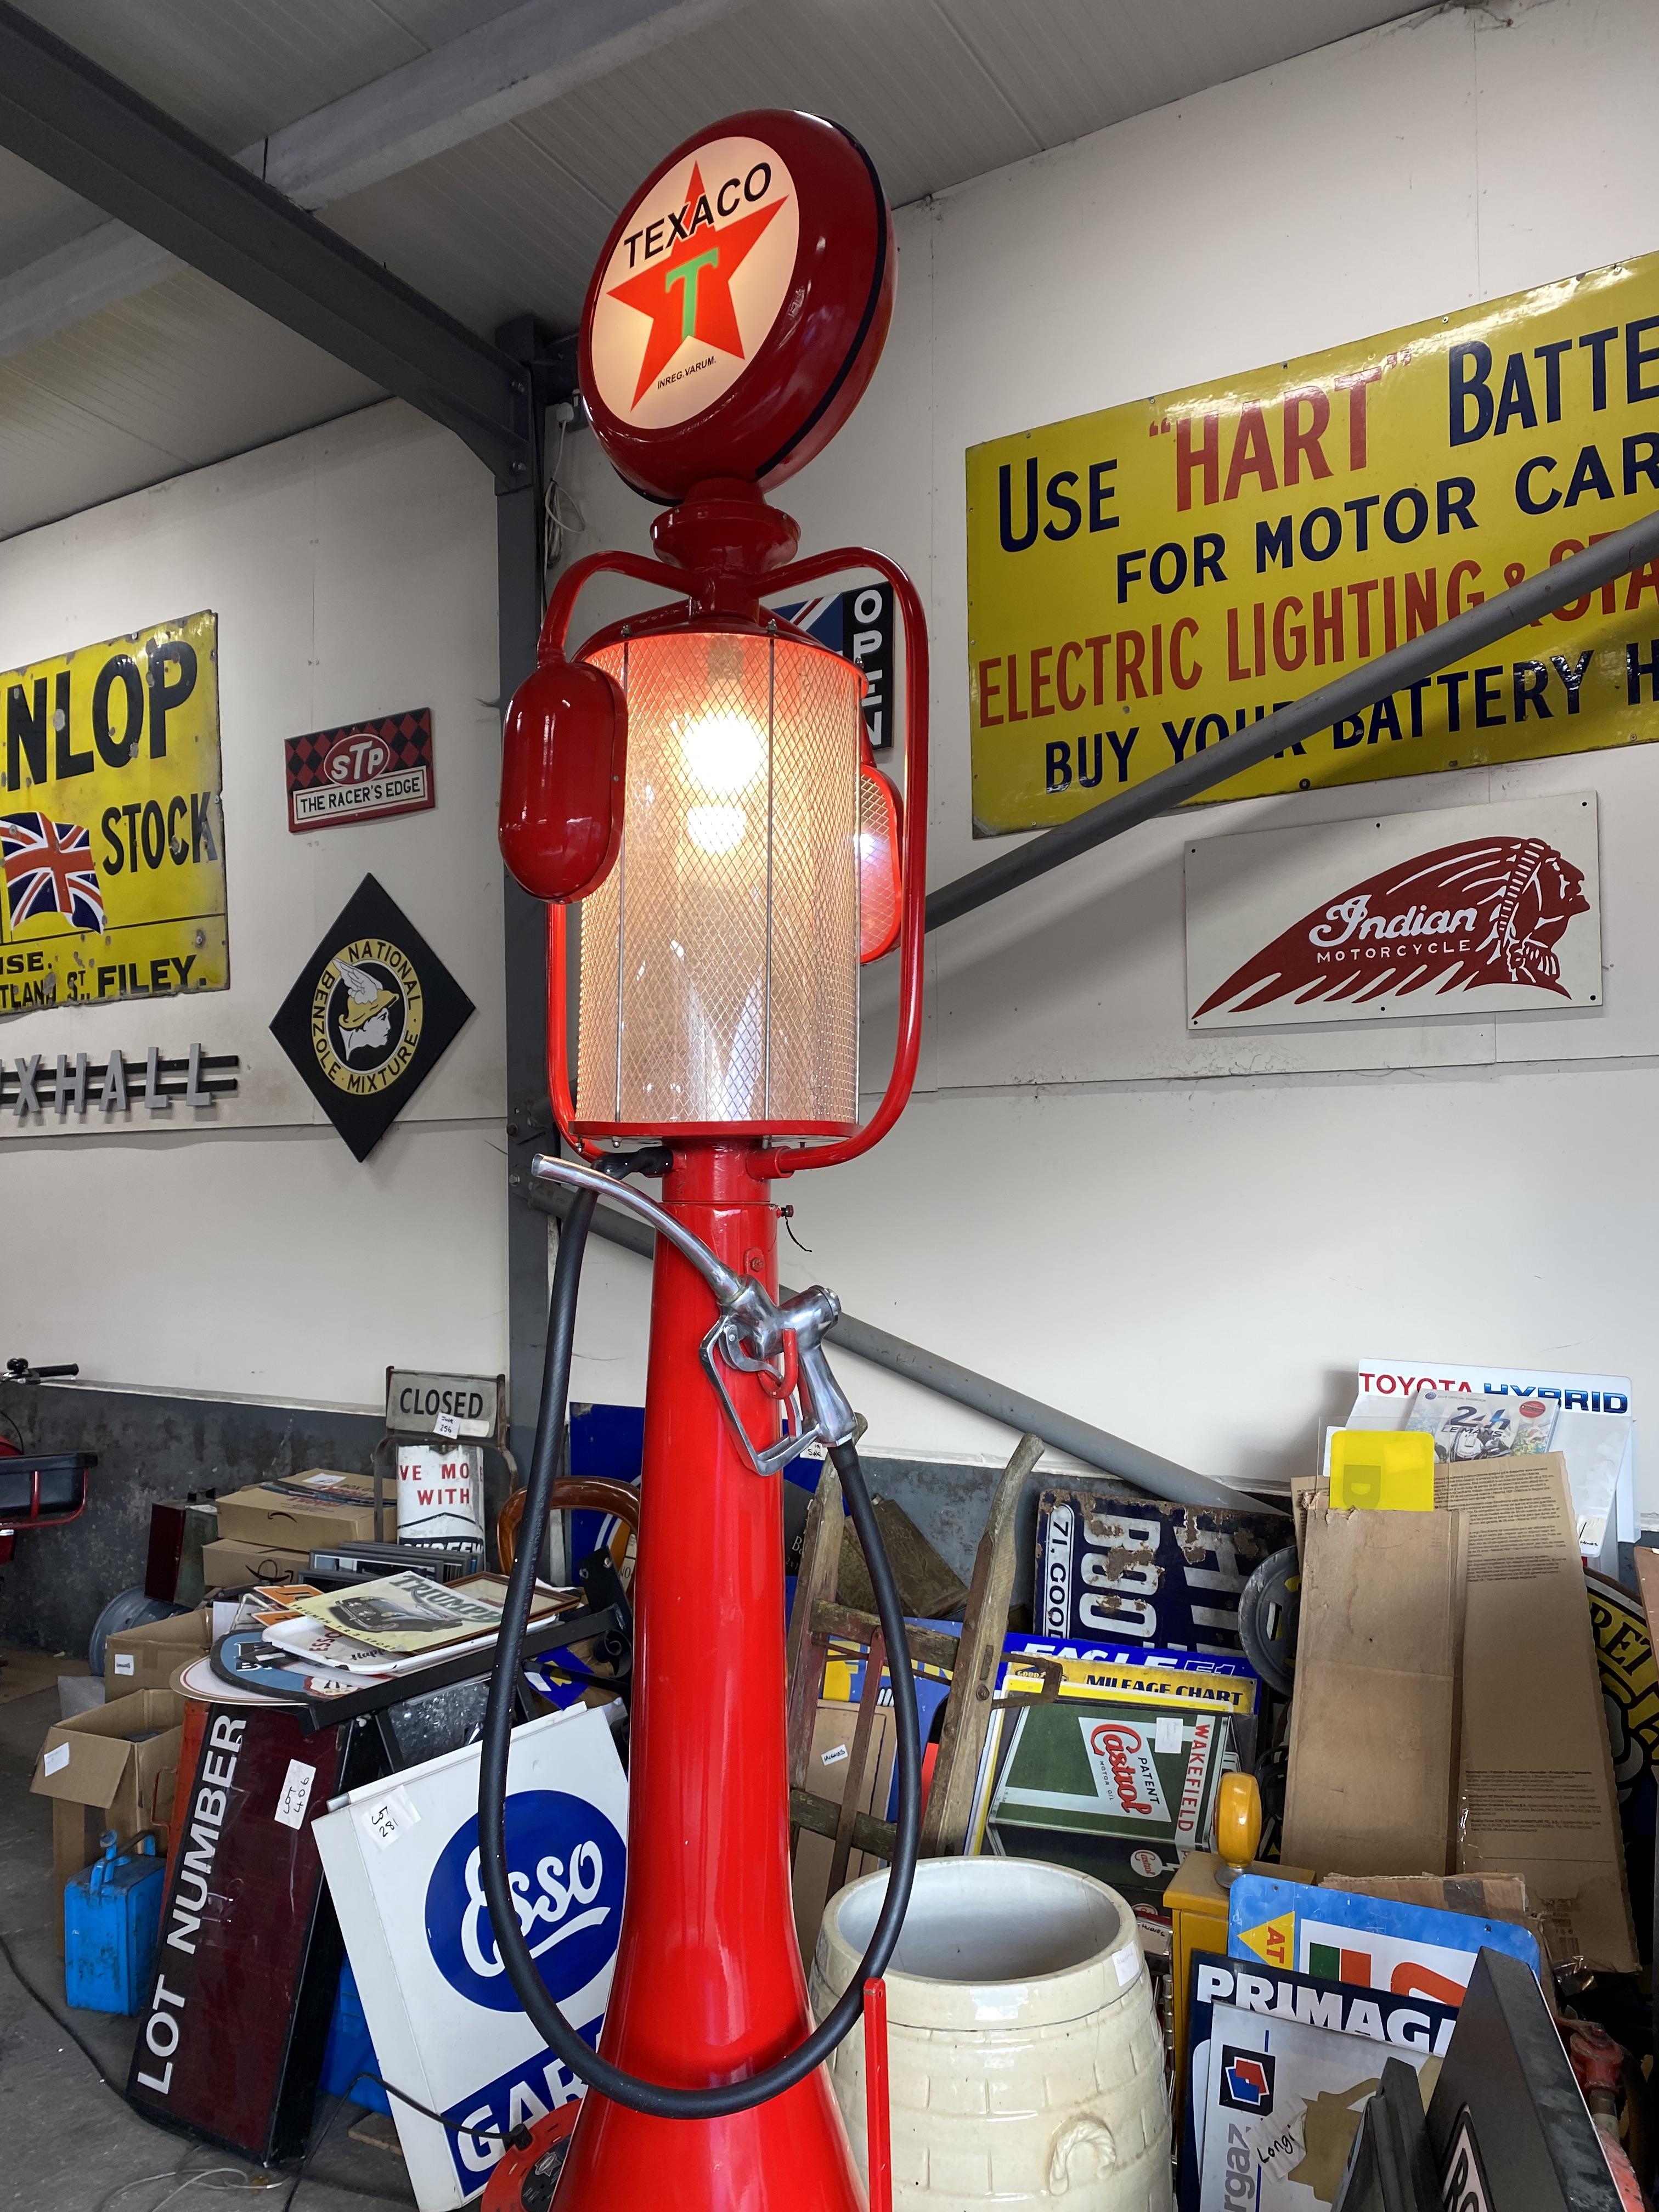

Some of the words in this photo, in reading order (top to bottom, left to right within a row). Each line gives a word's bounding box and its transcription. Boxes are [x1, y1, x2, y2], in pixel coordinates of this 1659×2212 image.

[624, 162, 771, 268] TEXACO
[665, 246, 719, 341] T
[1000, 457, 1120, 553] USE
[1117, 532, 1228, 603] FOR
[1256, 476, 1478, 573] MOTOR
[1515, 431, 1659, 515] CAR
[979, 617, 1203, 728] ELECTRIC
[1227, 559, 1485, 683] LIGHTING
[1046, 727, 1139, 794] BUY
[1333, 649, 1594, 750] BATTERY
[331, 741, 384, 780] STP
[301, 795, 325, 812] THE
[329, 785, 382, 808] RACER'S
[386, 777, 420, 797] EDGE
[101, 792, 218, 876] STOCK
[1309, 894, 1477, 947] Indian
[1317, 940, 1470, 963] MOTORCYCLE
[98, 955, 207, 998] FILEY.
[348, 941, 421, 1010] NATIONAL
[313, 970, 341, 1081] BENZOLE
[0, 1042, 212, 1117] XHALL
[347, 1030, 419, 1093] MIXTURE
[400, 1388, 483, 1419] CLOSED
[1359, 1373, 1471, 1396] TOYOTA
[417, 1488, 470, 1505] WITH
[309, 1631, 343, 1651] ESSO
[1176, 1685, 1244, 1706] CHART
[293, 1776, 309, 1812] 406
[1090, 1724, 1153, 1815] Castrol
[1099, 1760, 1110, 1785] MOTOR
[1138, 1757, 1160, 1804] PATENT
[1177, 1724, 1210, 1831] WAKEFIELD
[1135, 1850, 1156, 1876] Castrol
[137, 1974, 185, 2095] LOT
[166, 1714, 247, 1955] NUMBER
[461, 1839, 602, 1977] Esso
